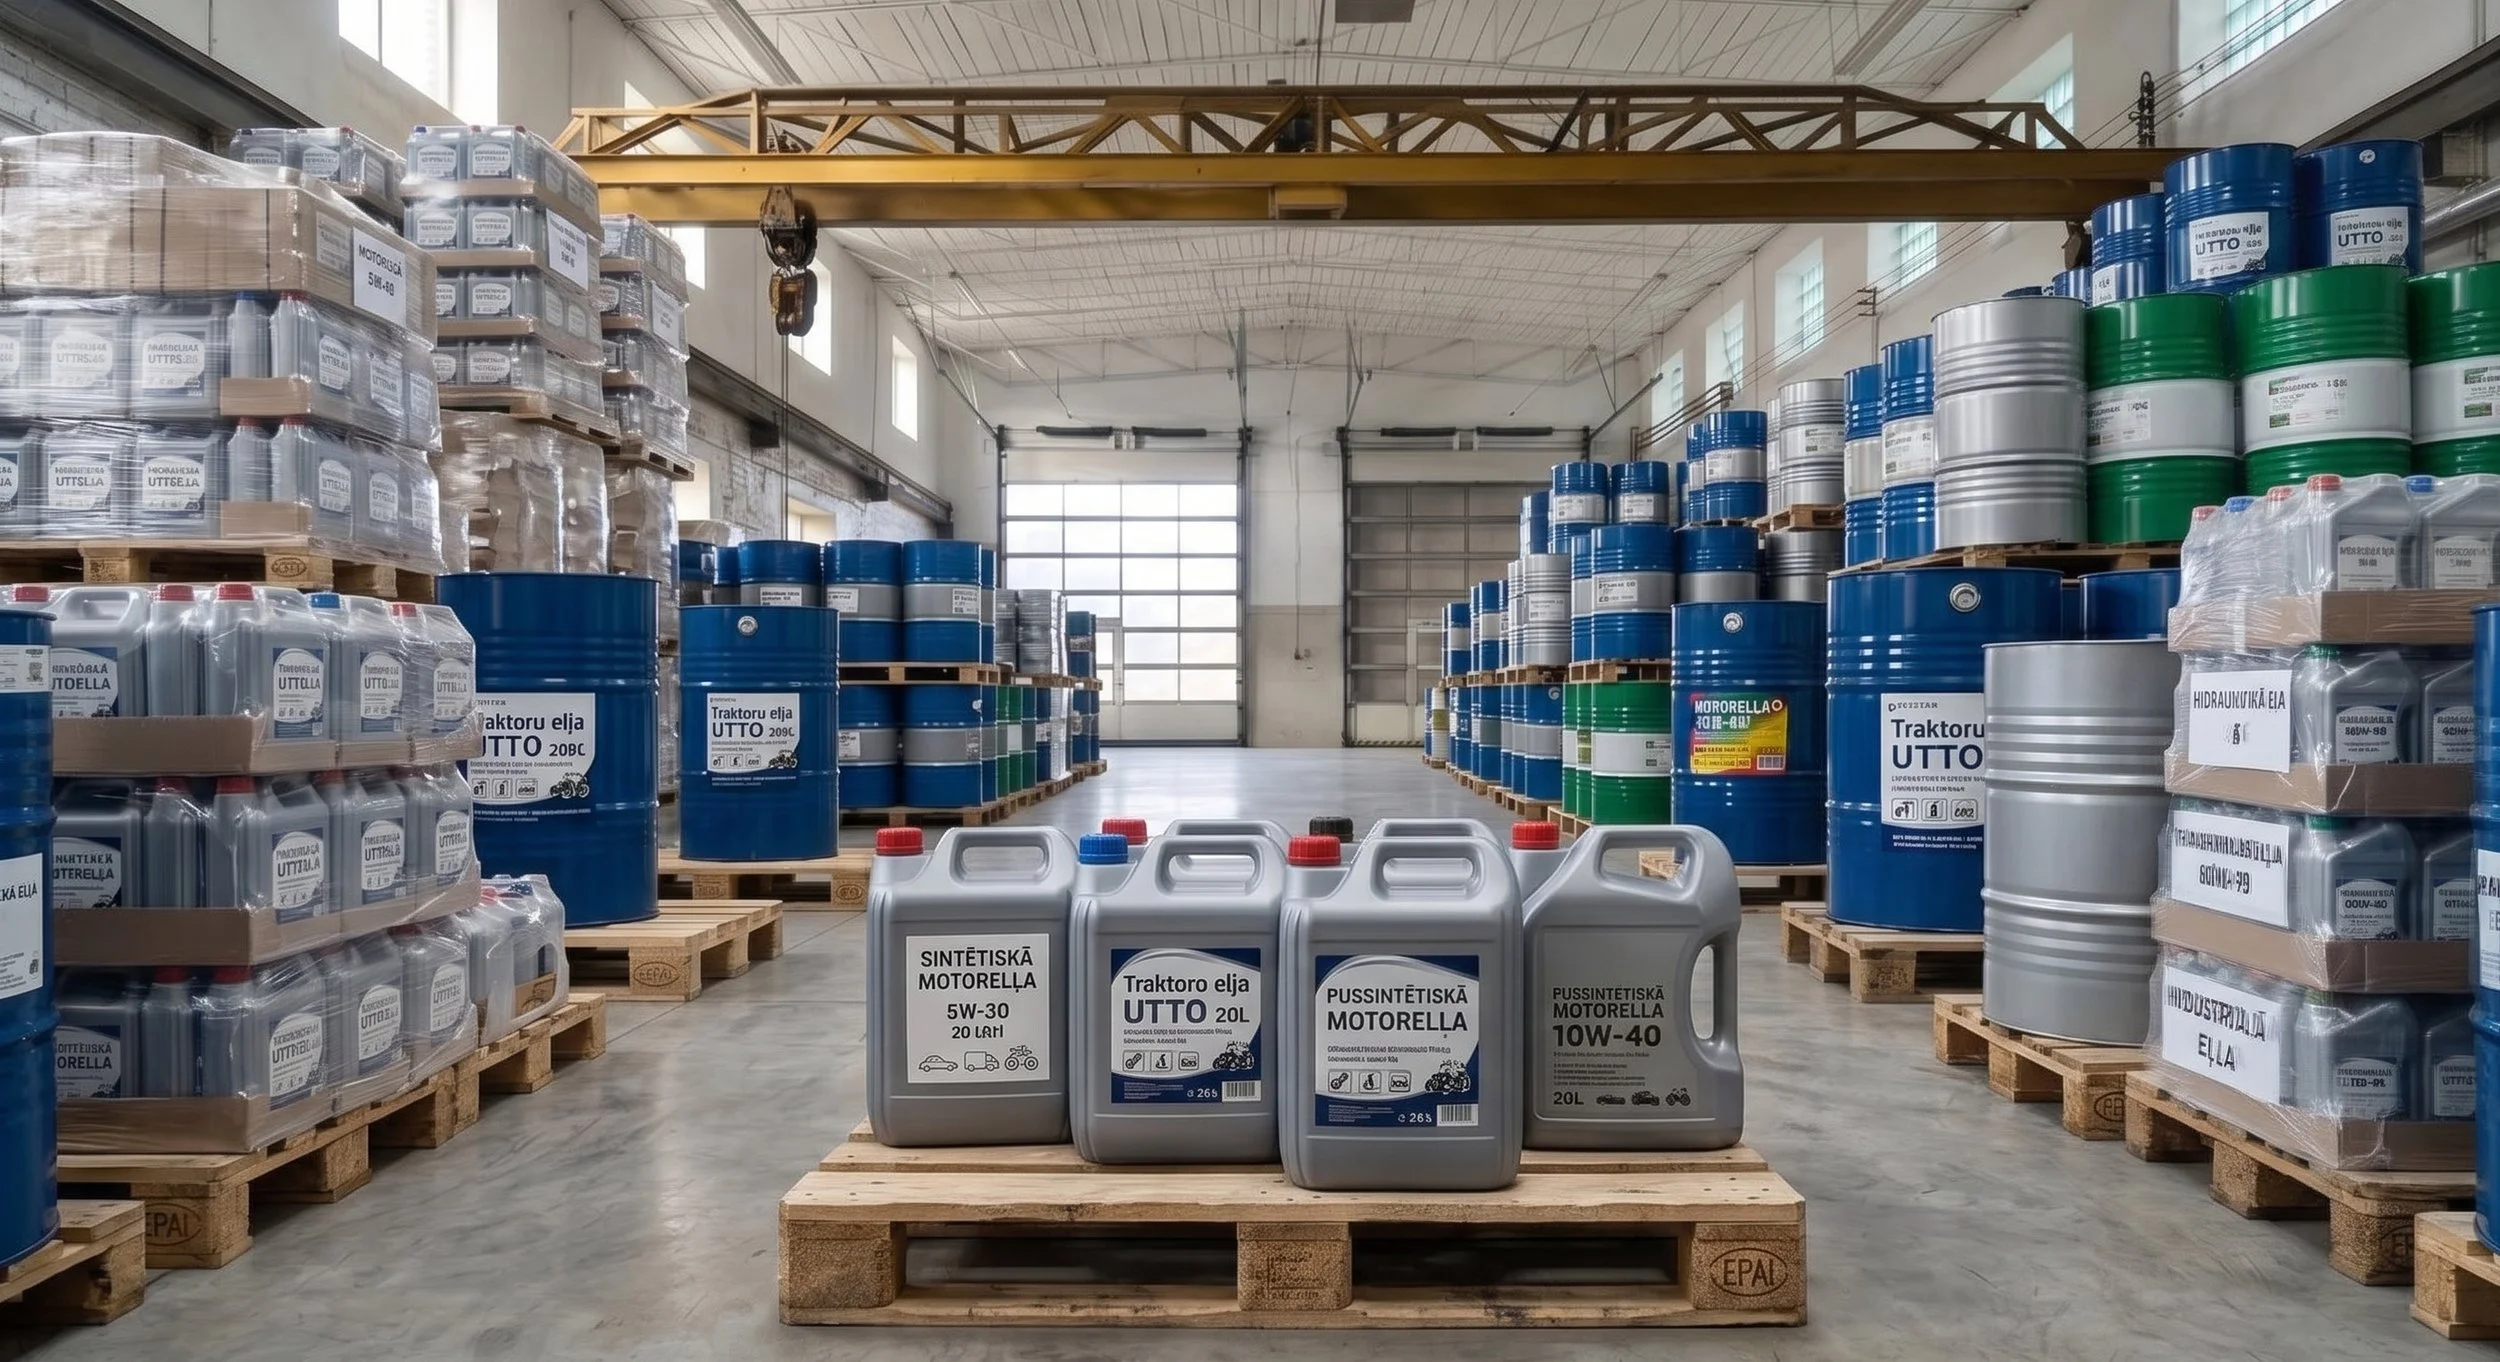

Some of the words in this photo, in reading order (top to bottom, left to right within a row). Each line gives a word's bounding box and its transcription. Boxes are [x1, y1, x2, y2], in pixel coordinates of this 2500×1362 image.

[2338, 230, 2383, 247] UTTO
[711, 706, 766, 720] Traktoru
[712, 722, 764, 738] UTTO
[1890, 719, 1985, 738] Traktoru
[1892, 744, 1984, 770] UTTO
[920, 946, 1034, 967] SINTĒTISKĀ
[1123, 974, 1208, 993] Traktoro
[1214, 973, 1250, 997] elja
[1327, 984, 1468, 1004] PUSSINTĒTISKĀ
[947, 1002, 1010, 1020] 5W-30
[1124, 999, 1207, 1024] UTTO
[1215, 1007, 1250, 1023] 20L
[1553, 1002, 1665, 1019] MOTORELLA
[951, 1026, 971, 1039] 20
[1552, 1024, 1661, 1047] 10W-40
[56, 1056, 112, 1070] ORELLA
[1553, 1091, 1585, 1105] 20L
[1723, 1258, 1775, 1287] EPAI
